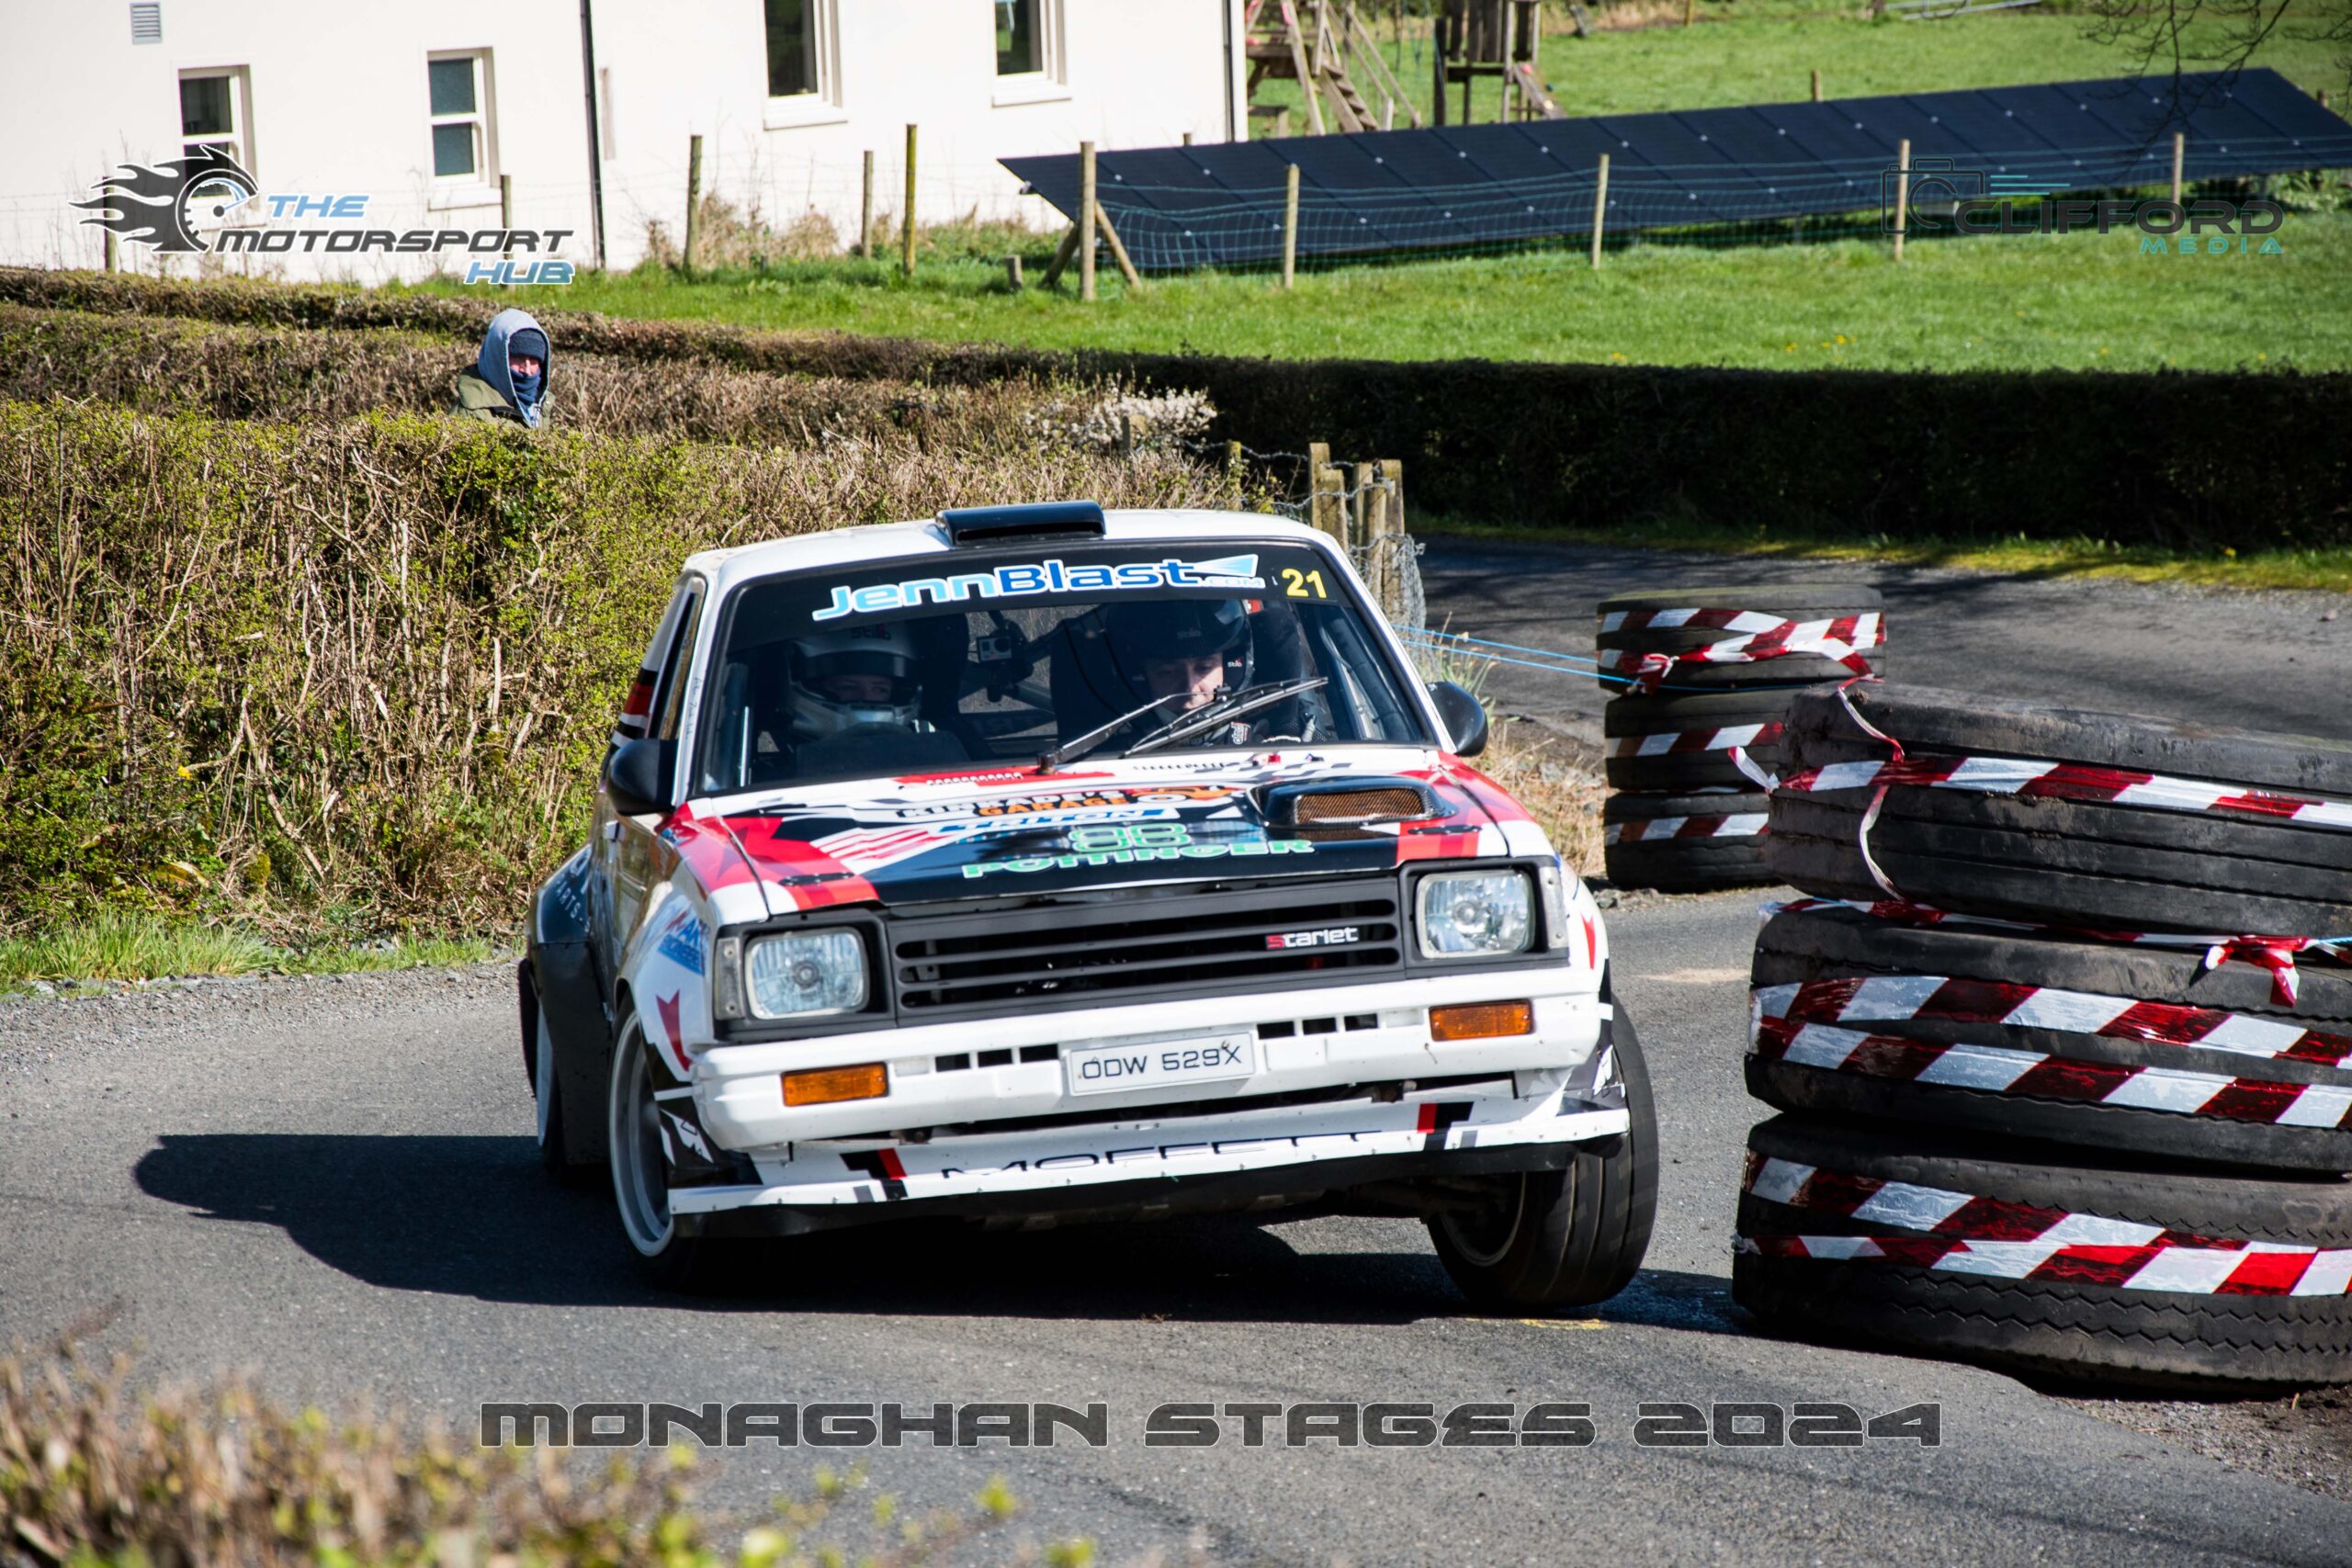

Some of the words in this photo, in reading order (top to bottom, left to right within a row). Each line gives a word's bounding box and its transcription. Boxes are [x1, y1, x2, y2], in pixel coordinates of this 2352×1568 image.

[1282, 568, 1327, 598] 21
[978, 796, 1129, 817] GARAGE
[1266, 927, 1359, 950] Starlet
[1082, 1055, 1148, 1079] ODW
[1161, 1045, 1242, 1071] 529X
